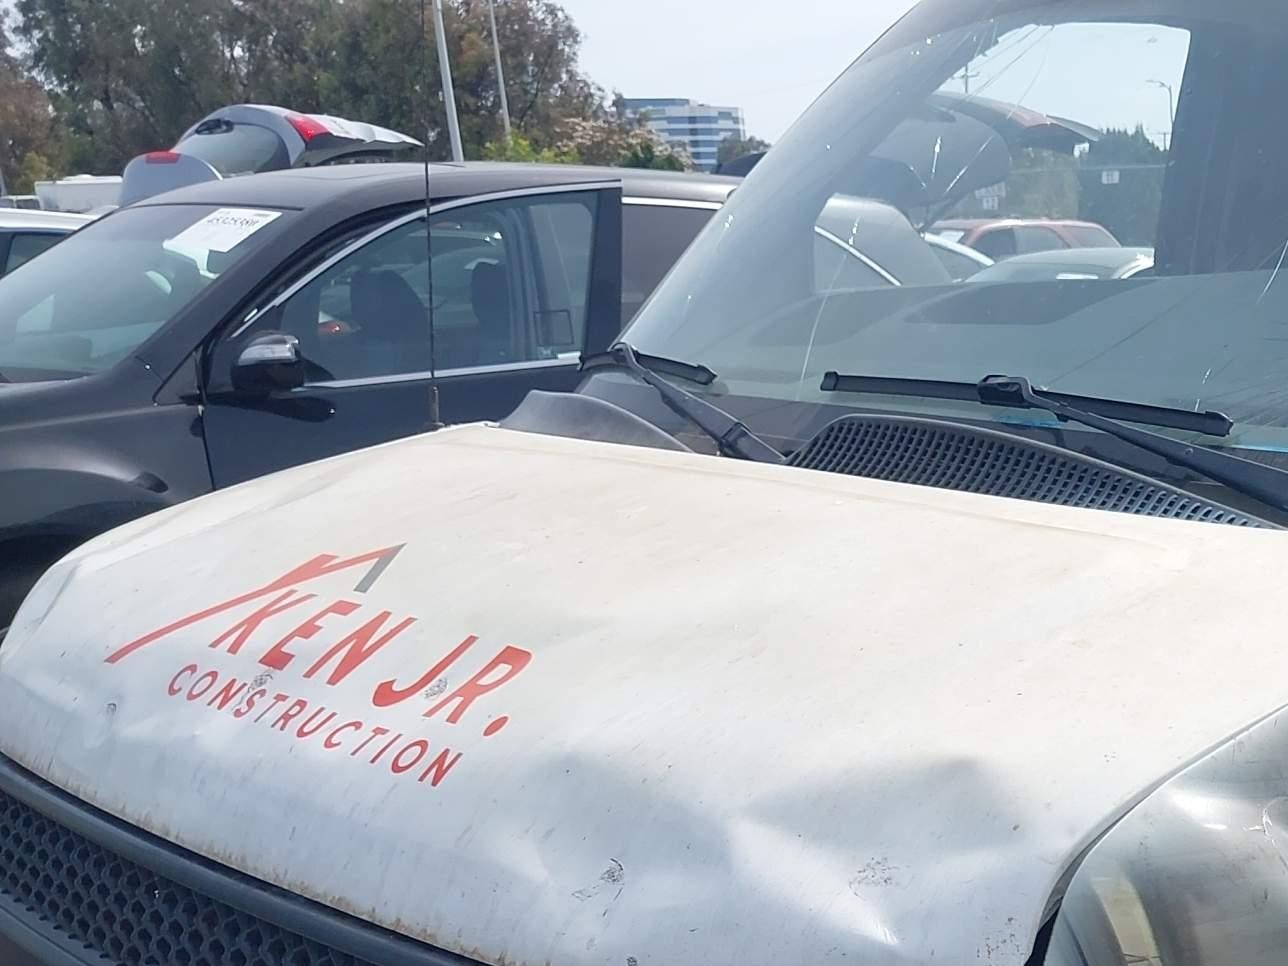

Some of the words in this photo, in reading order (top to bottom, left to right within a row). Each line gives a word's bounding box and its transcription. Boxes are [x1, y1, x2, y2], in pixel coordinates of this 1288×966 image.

[167, 663, 464, 788] CONSTRUCTION
[208, 589, 419, 687] KEN
[371, 634, 533, 738] JR.
